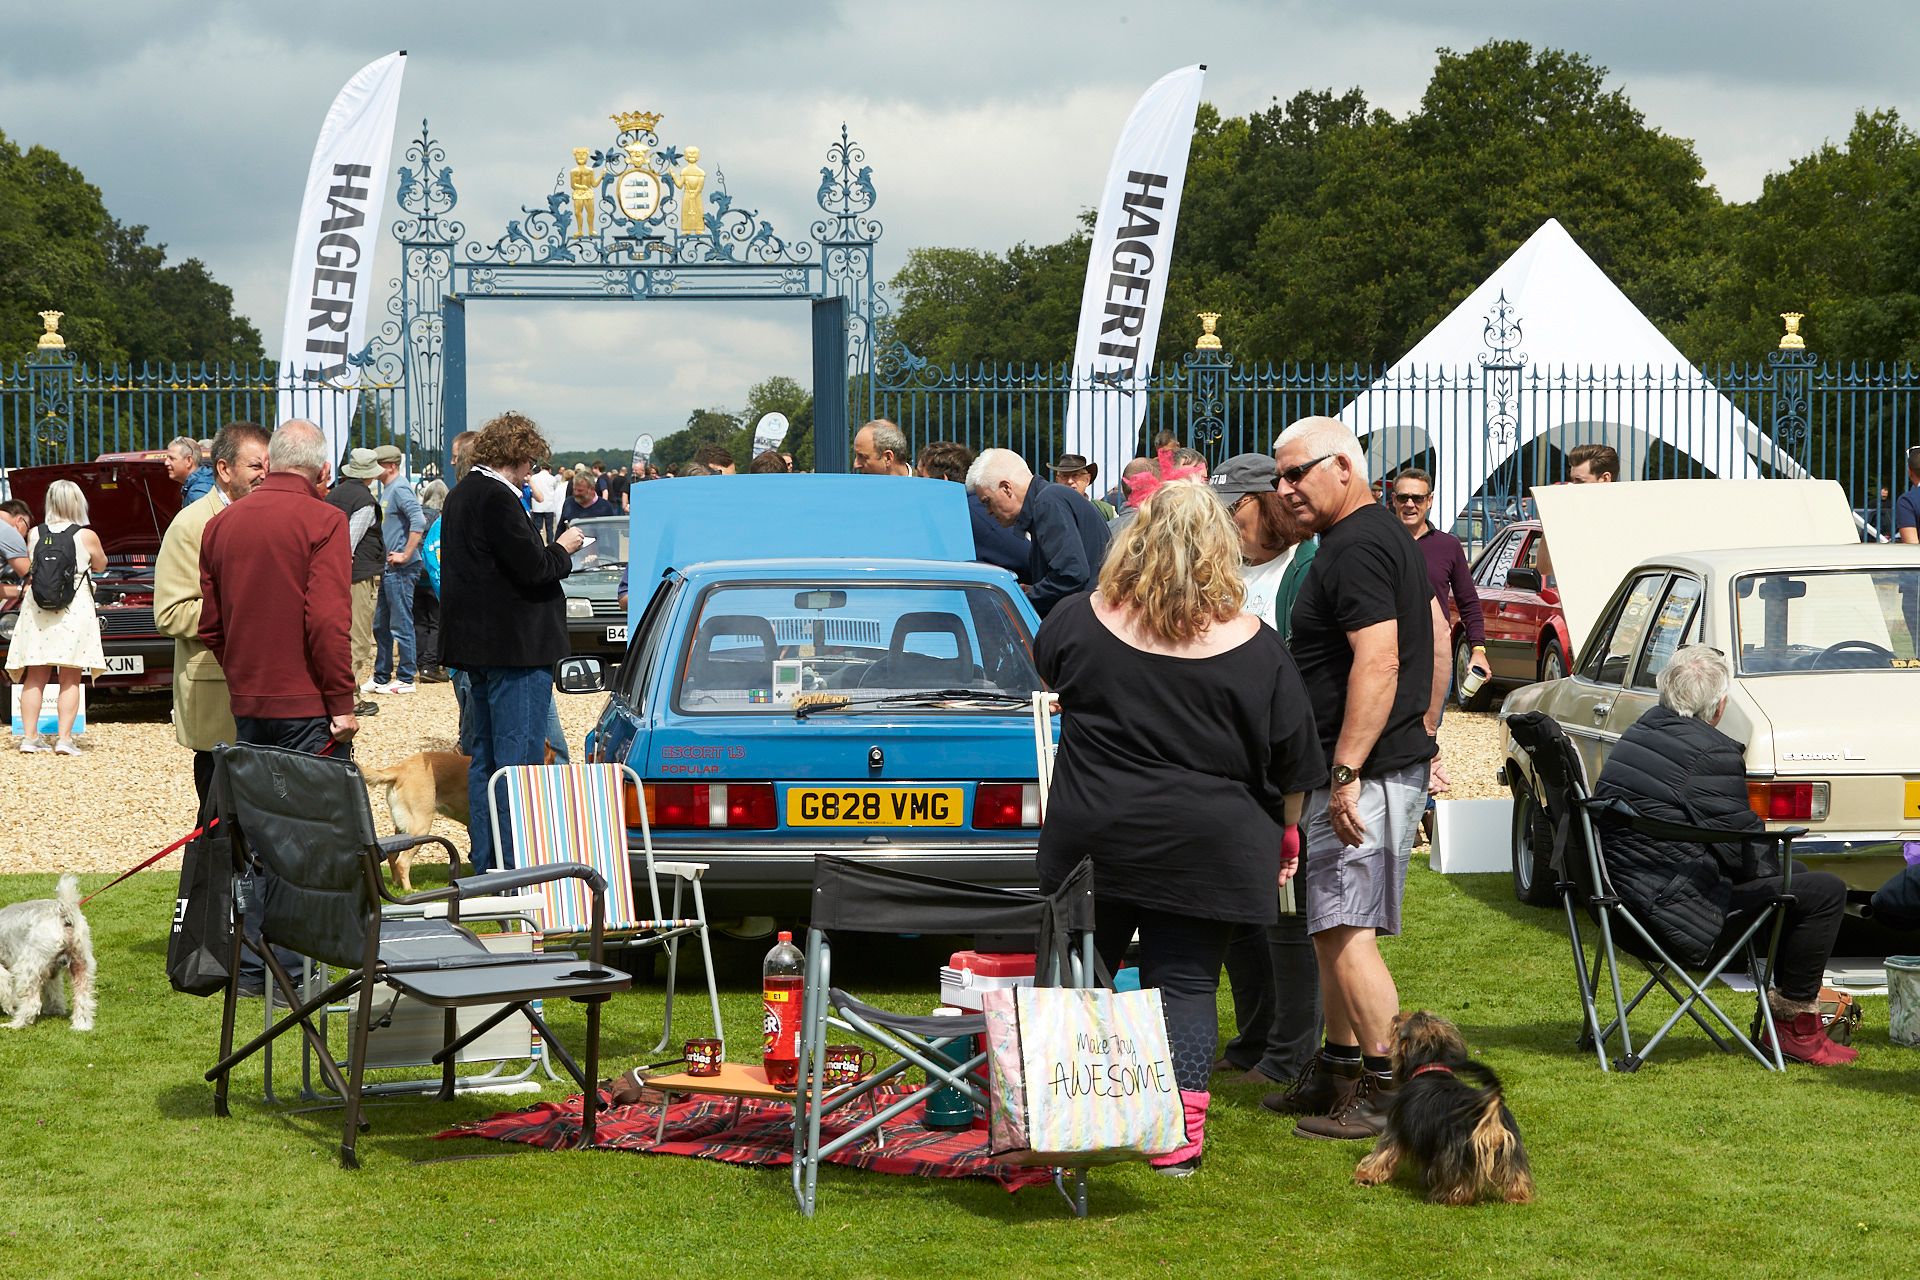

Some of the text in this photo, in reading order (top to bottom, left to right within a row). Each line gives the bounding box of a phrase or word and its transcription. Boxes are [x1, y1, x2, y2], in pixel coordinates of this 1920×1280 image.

[302, 163, 372, 395] HAGERTY
[1094, 170, 1169, 398] HAGERTY
[608, 628, 628, 639] B4
[662, 746, 746, 759] ESCORT 1.3
[661, 765, 719, 774] POPULAR
[801, 792, 949, 820] G828 VMG
[1076, 1032, 1110, 1055] Make
[686, 1053, 711, 1064] arties
[826, 1060, 859, 1072] marties
[1048, 1061, 1171, 1100] AWESOME
